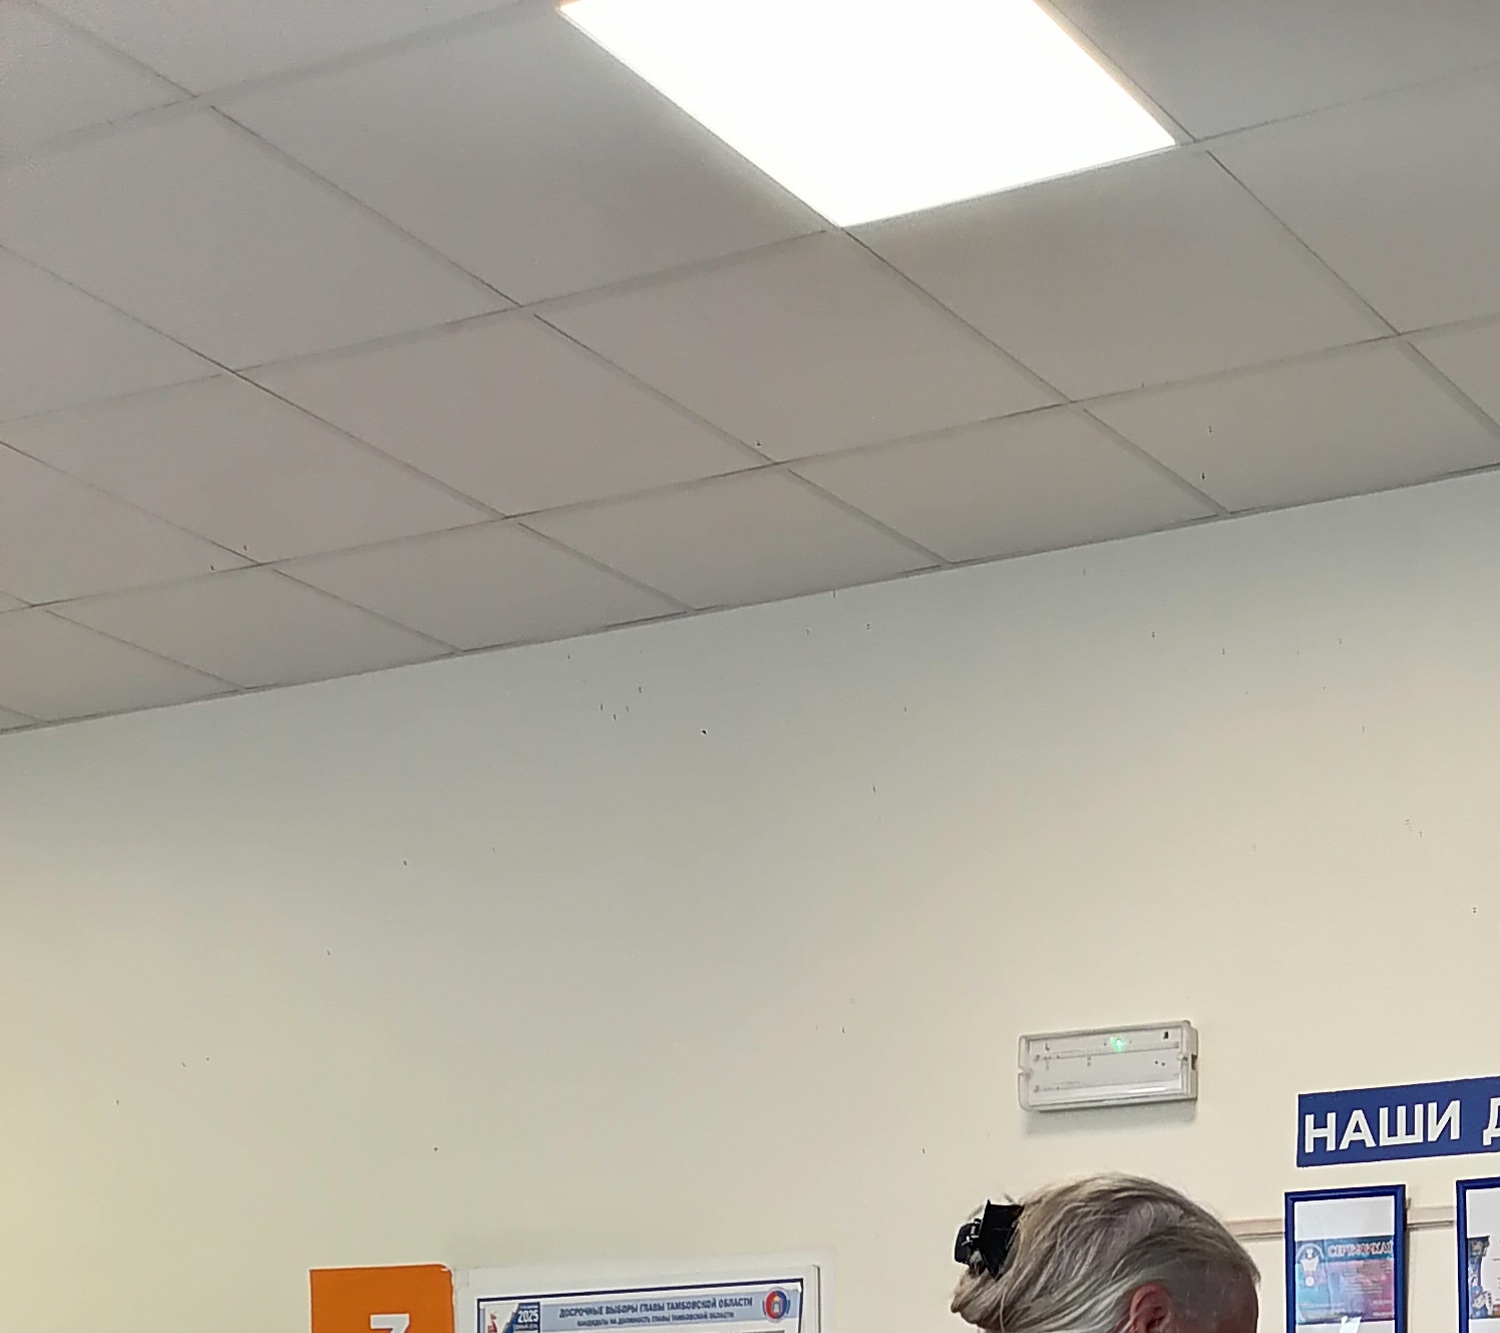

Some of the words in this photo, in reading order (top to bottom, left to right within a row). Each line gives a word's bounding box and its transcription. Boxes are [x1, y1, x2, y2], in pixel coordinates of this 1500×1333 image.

[1303, 1100, 1462, 1154] НАШИ
[605, 1303, 638, 1314] ВЫБОРЫ
[640, 1302, 665, 1312] ГЛАВЫ
[667, 1298, 717, 1310] ТАМБОВСКОЙ
[719, 1297, 753, 1308] ОБЛАСТИ
[518, 1310, 539, 1323] 2025
